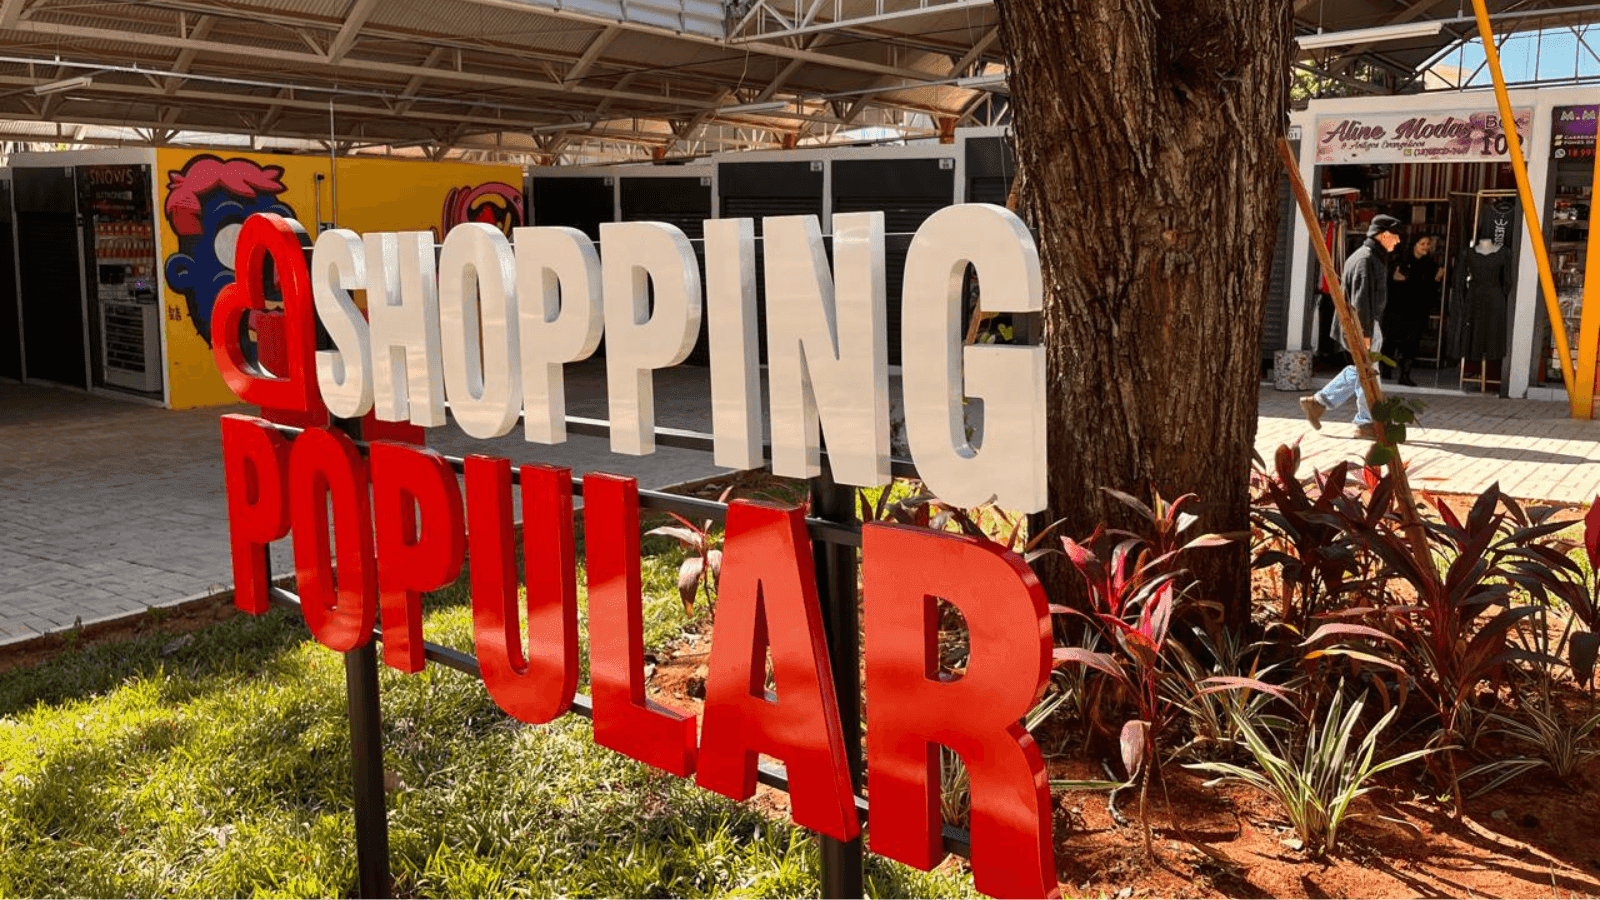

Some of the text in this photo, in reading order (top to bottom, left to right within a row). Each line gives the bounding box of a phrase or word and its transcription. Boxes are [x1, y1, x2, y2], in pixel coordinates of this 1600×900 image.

[1322, 116, 1473, 144] Aline Modas
[1486, 114, 1521, 129] Bx
[90, 168, 134, 185] SNOWS
[312, 203, 1047, 513] SHOPPING
[221, 414, 1059, 900] POPULAR
